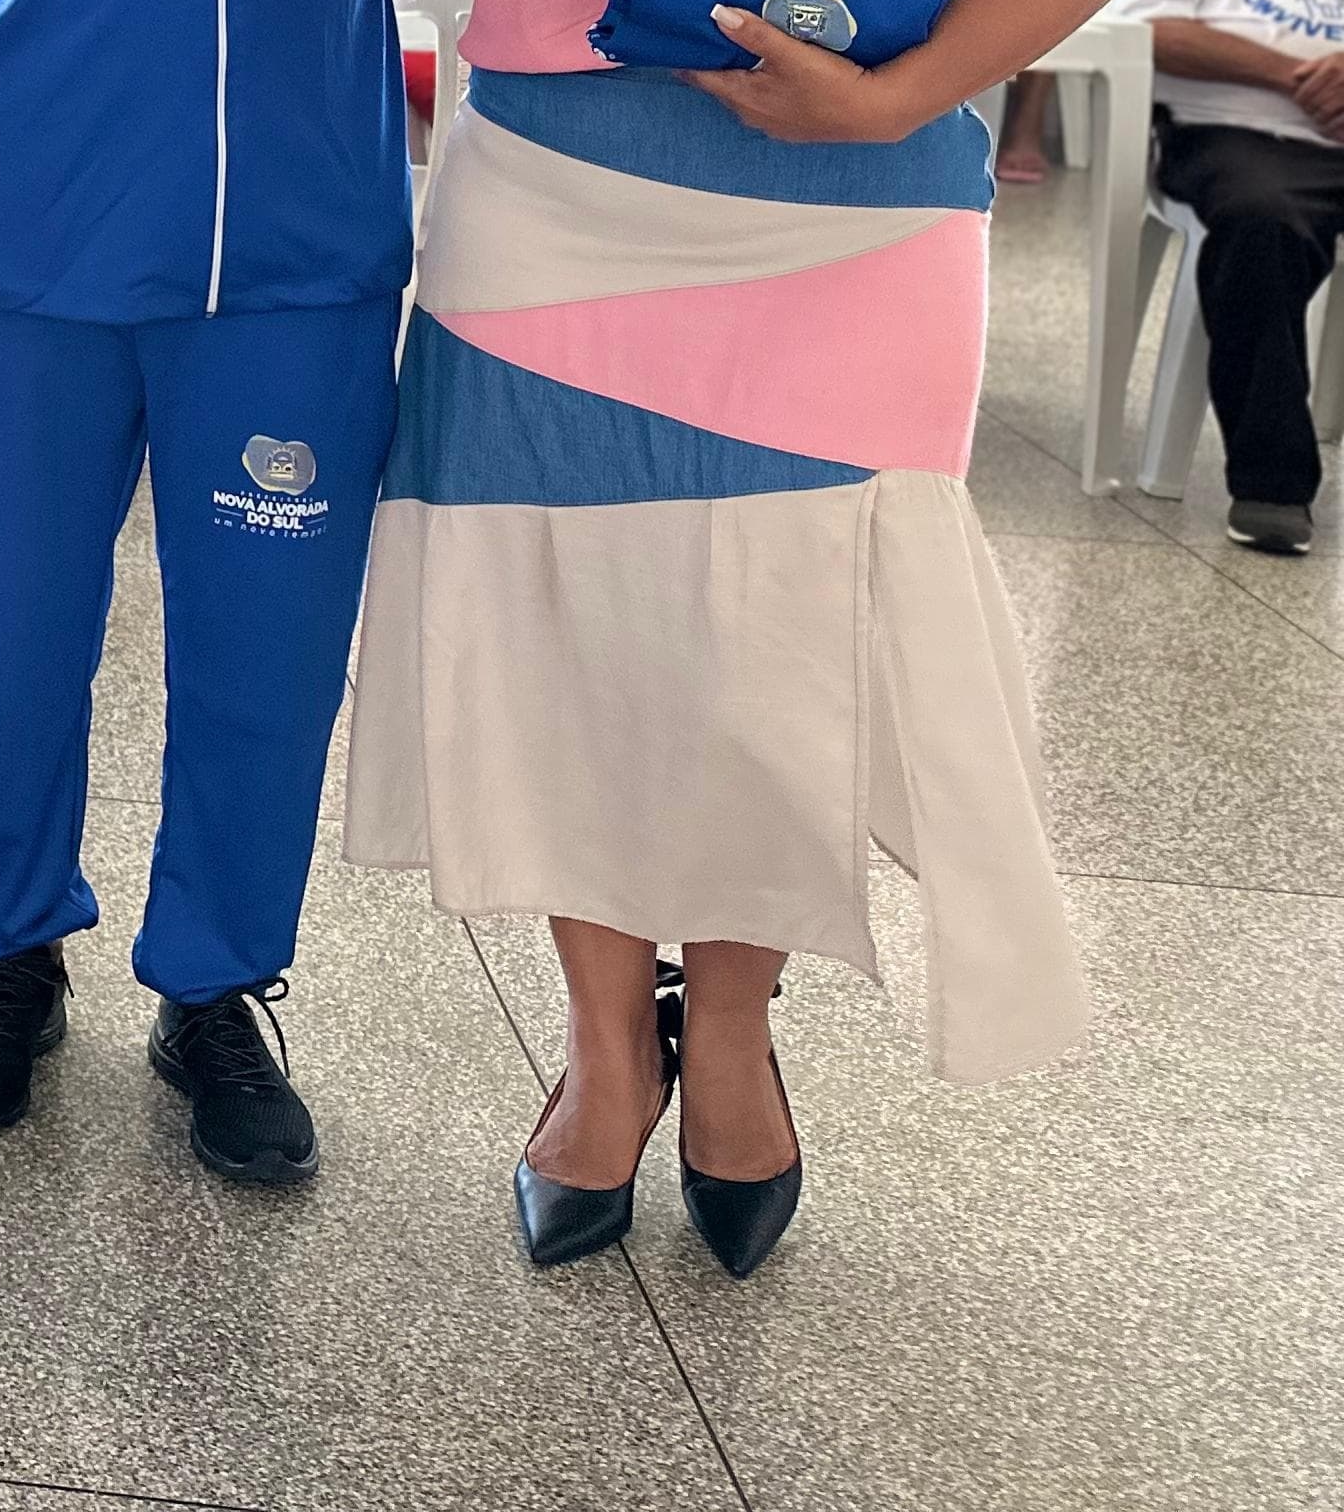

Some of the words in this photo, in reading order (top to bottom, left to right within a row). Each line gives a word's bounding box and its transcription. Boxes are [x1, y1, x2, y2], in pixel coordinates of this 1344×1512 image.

[213, 490, 256, 511] NOVA
[257, 500, 329, 517] ALVORADA
[214, 517, 233, 527] um
[240, 523, 276, 537] novo
[246, 510, 270, 527] DO
[272, 515, 304, 530] SUL
